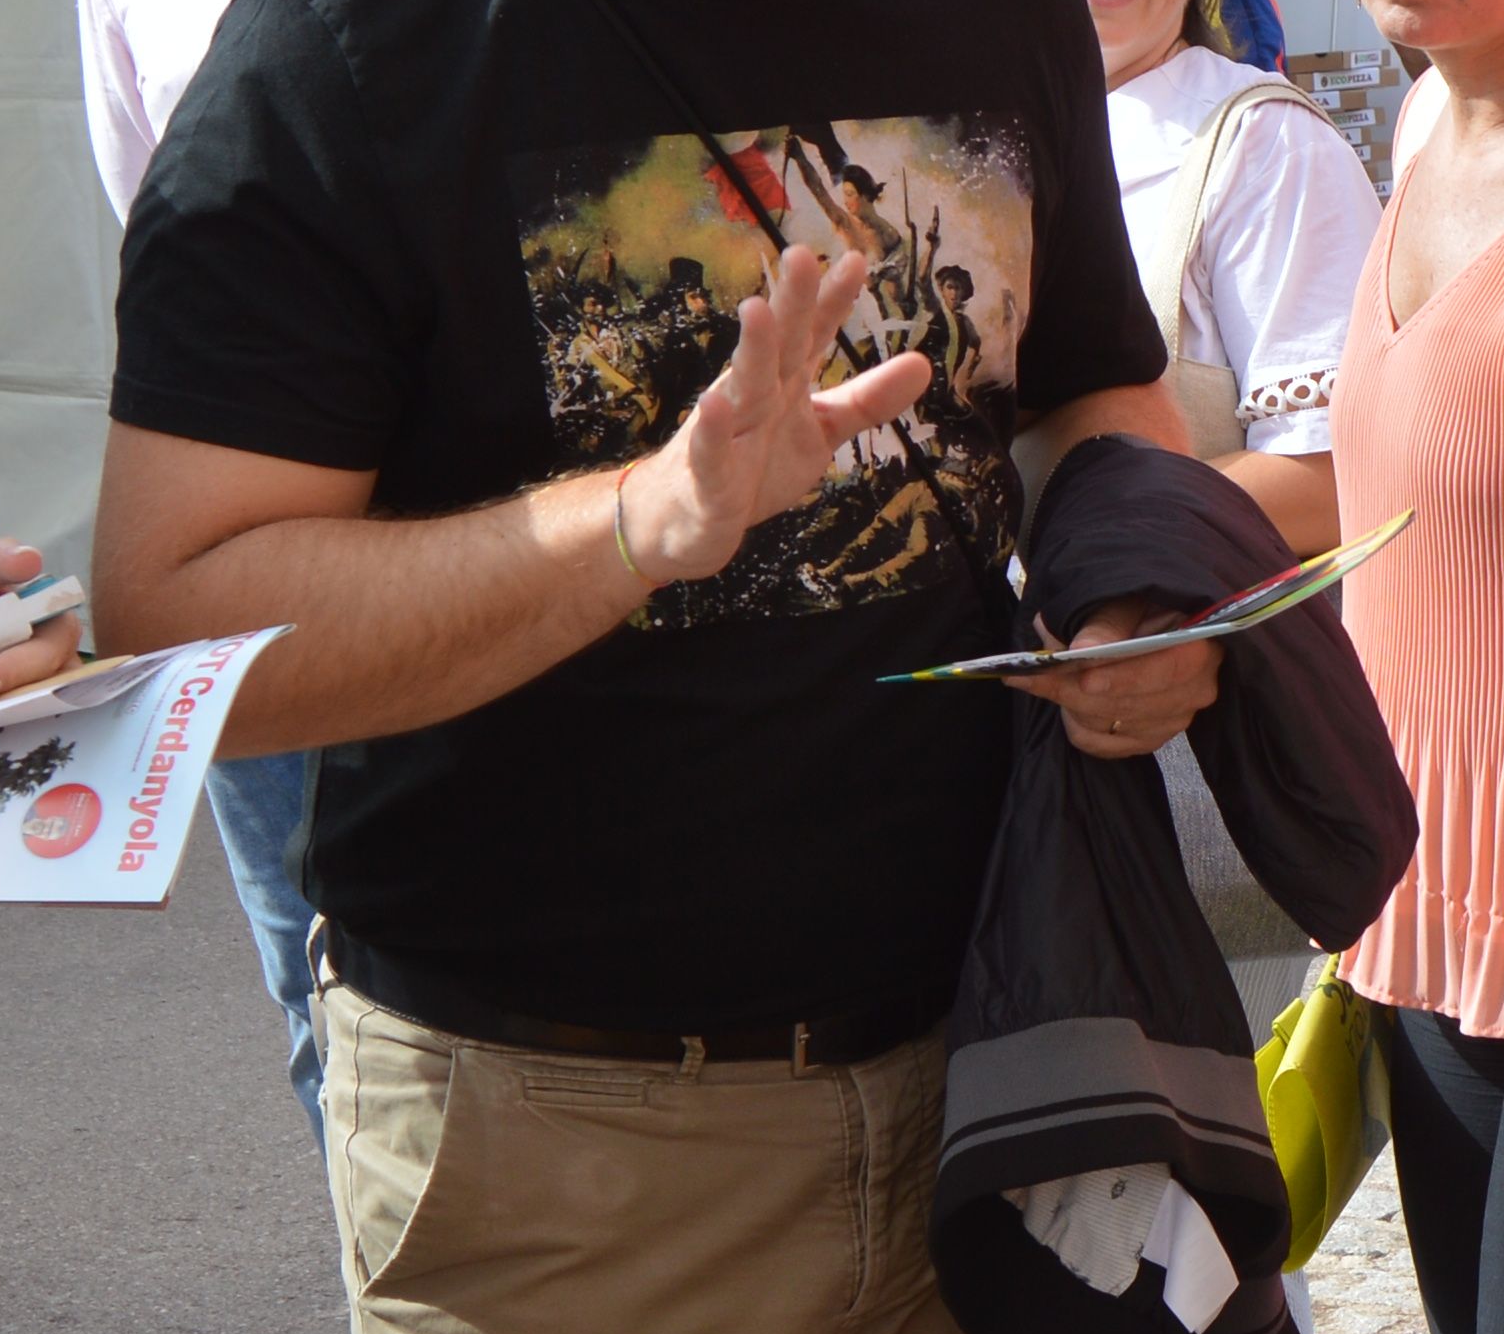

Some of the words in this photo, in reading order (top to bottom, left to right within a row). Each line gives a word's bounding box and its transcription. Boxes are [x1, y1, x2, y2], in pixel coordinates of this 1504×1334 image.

[1330, 73, 1373, 85] ECOPIZZA
[198, 632, 256, 673] TOT
[116, 674, 215, 873] Cerdanyola
